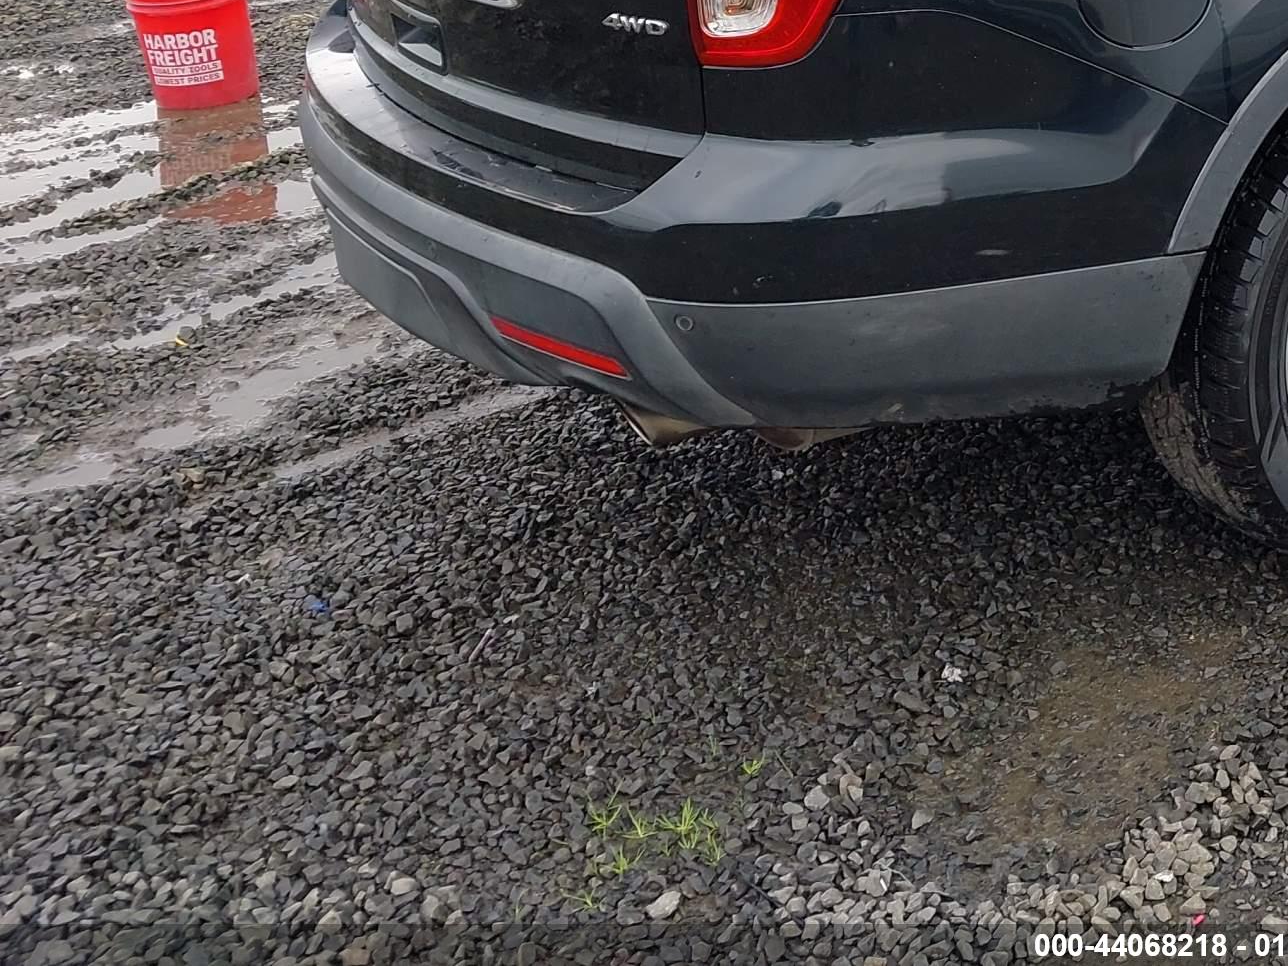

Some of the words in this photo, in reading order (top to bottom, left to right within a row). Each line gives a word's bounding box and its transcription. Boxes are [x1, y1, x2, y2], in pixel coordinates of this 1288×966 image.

[601, 13, 670, 36] 4WD
[142, 28, 217, 50] HARBOR
[146, 44, 219, 66] FREIGHT
[154, 67, 185, 76] QUALITY
[189, 62, 218, 73] TOOLS
[187, 72, 221, 84] PRICES
